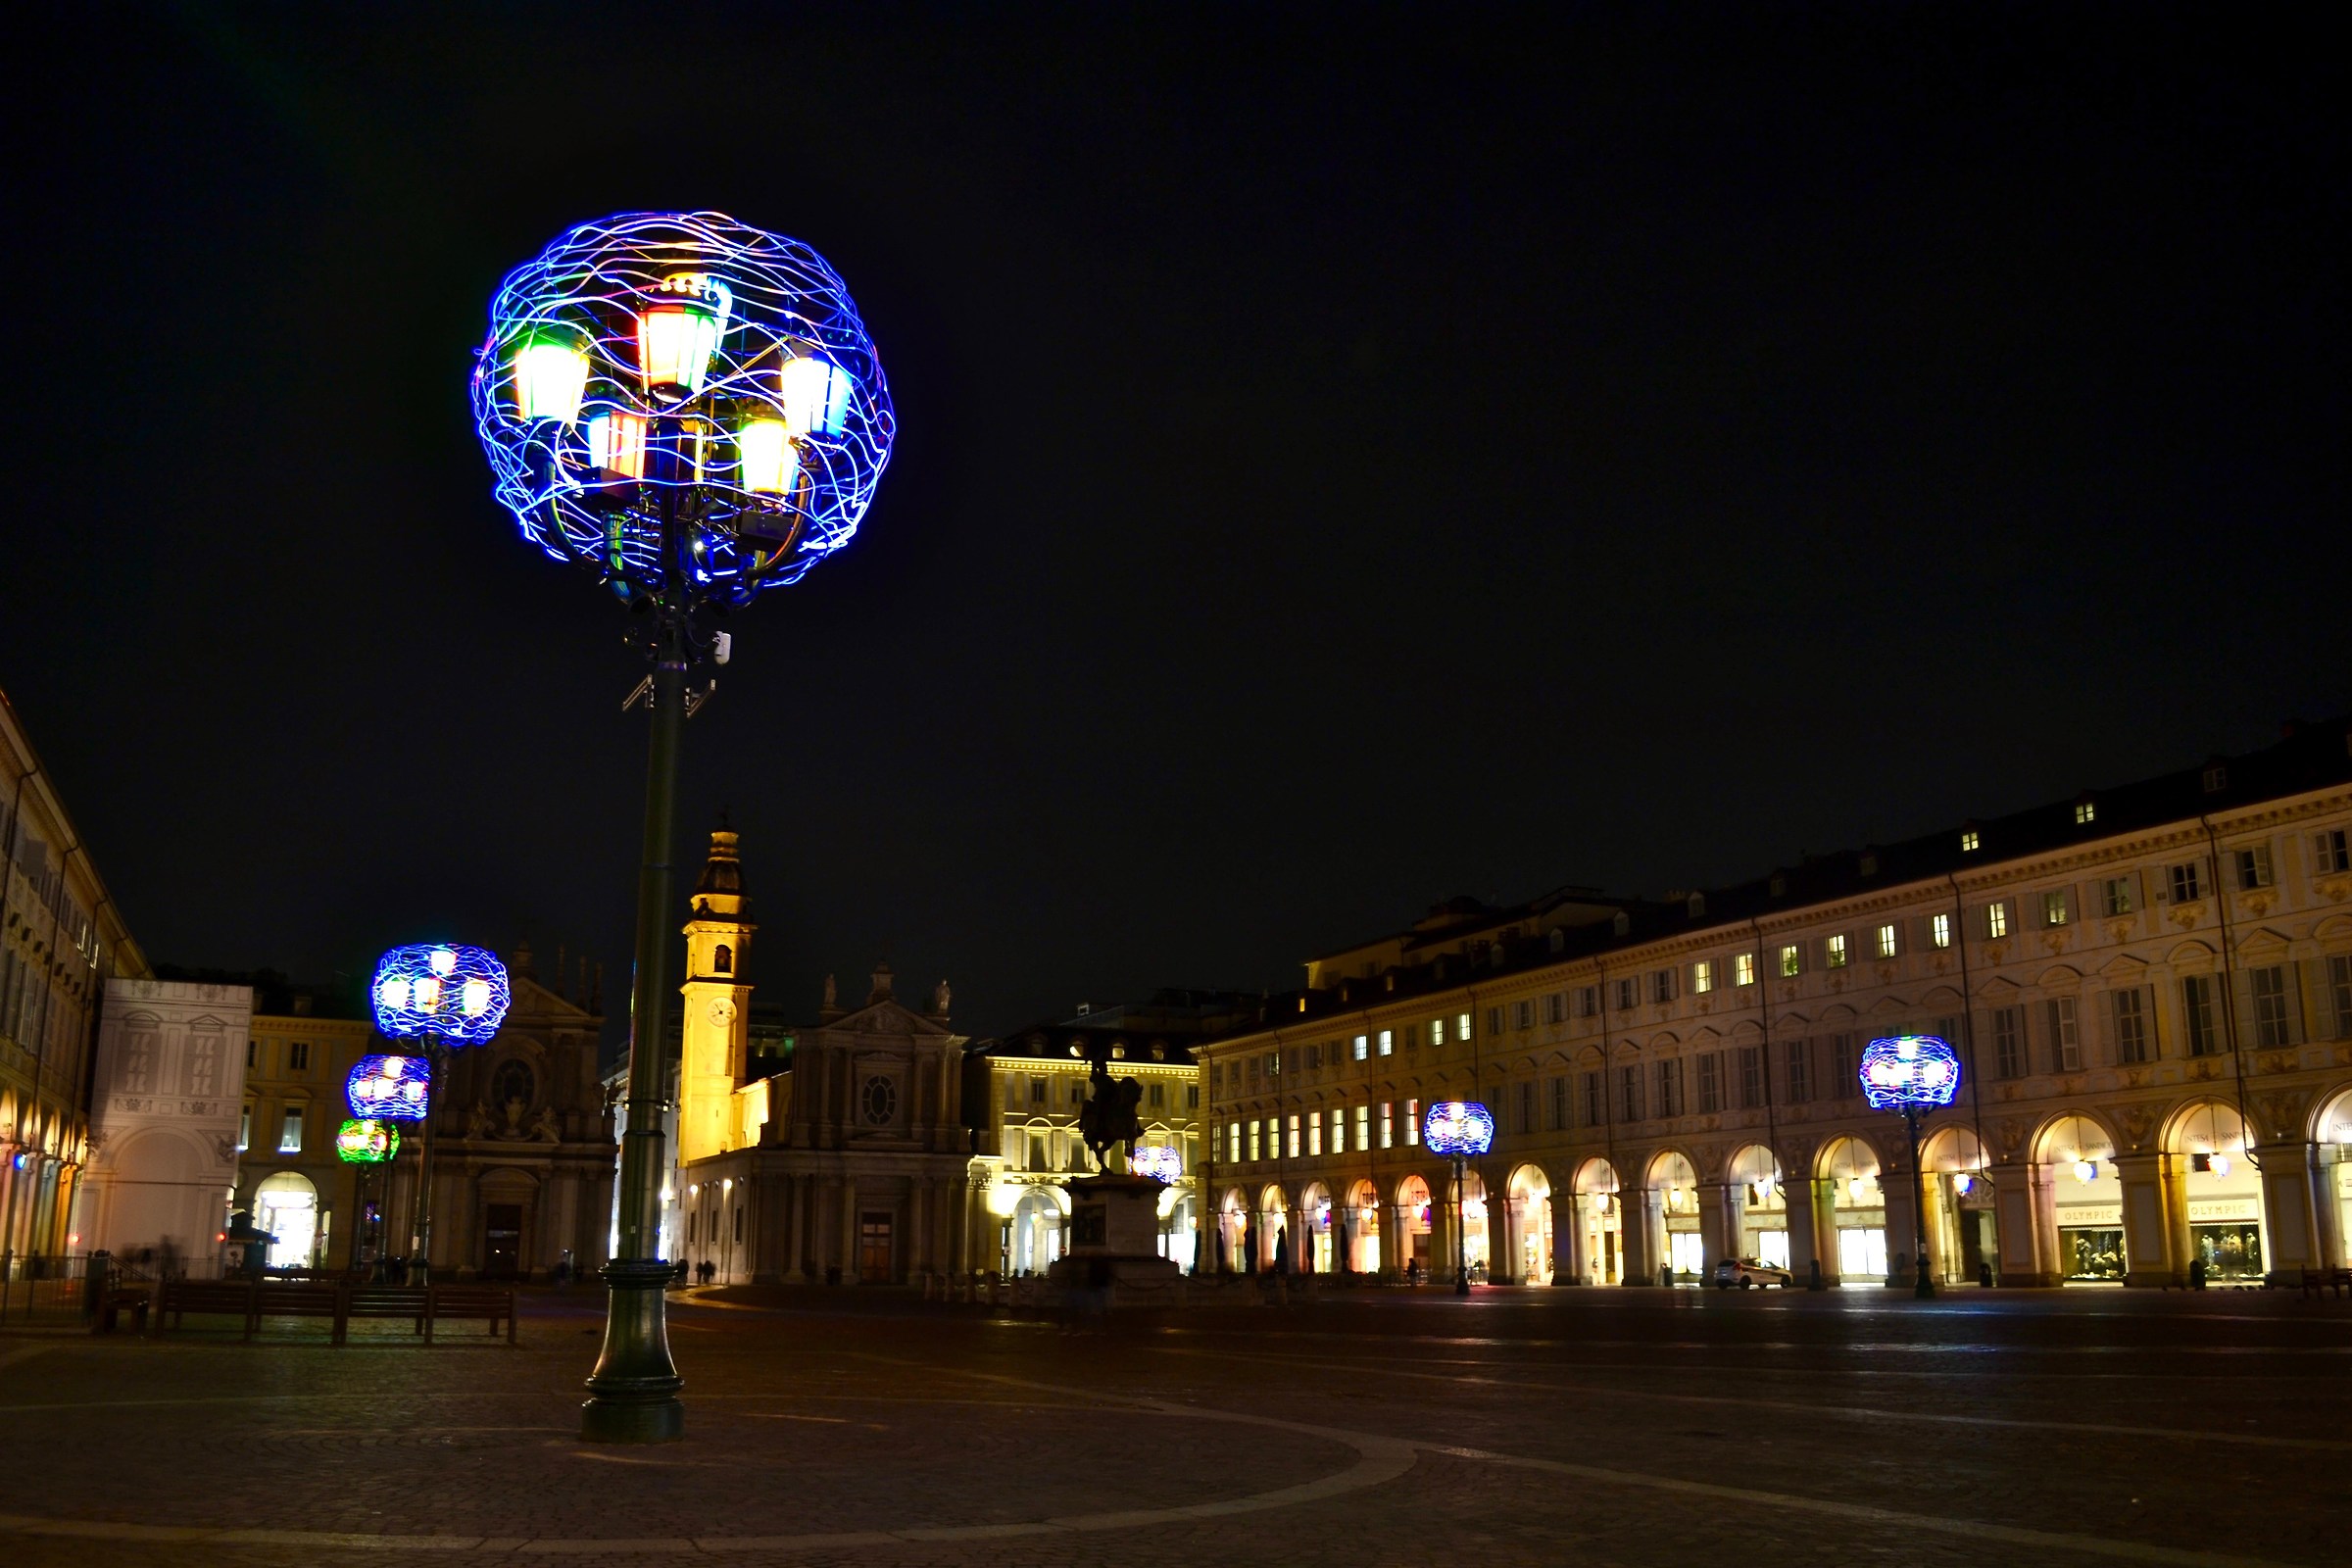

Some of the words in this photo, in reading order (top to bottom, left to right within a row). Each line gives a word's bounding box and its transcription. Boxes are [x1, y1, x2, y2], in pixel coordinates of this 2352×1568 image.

[2332, 1122, 2352, 1132] INTE
[2191, 1204, 2246, 1215] OLYMPIC
[2064, 1210, 2113, 1220] OLYMPIC
